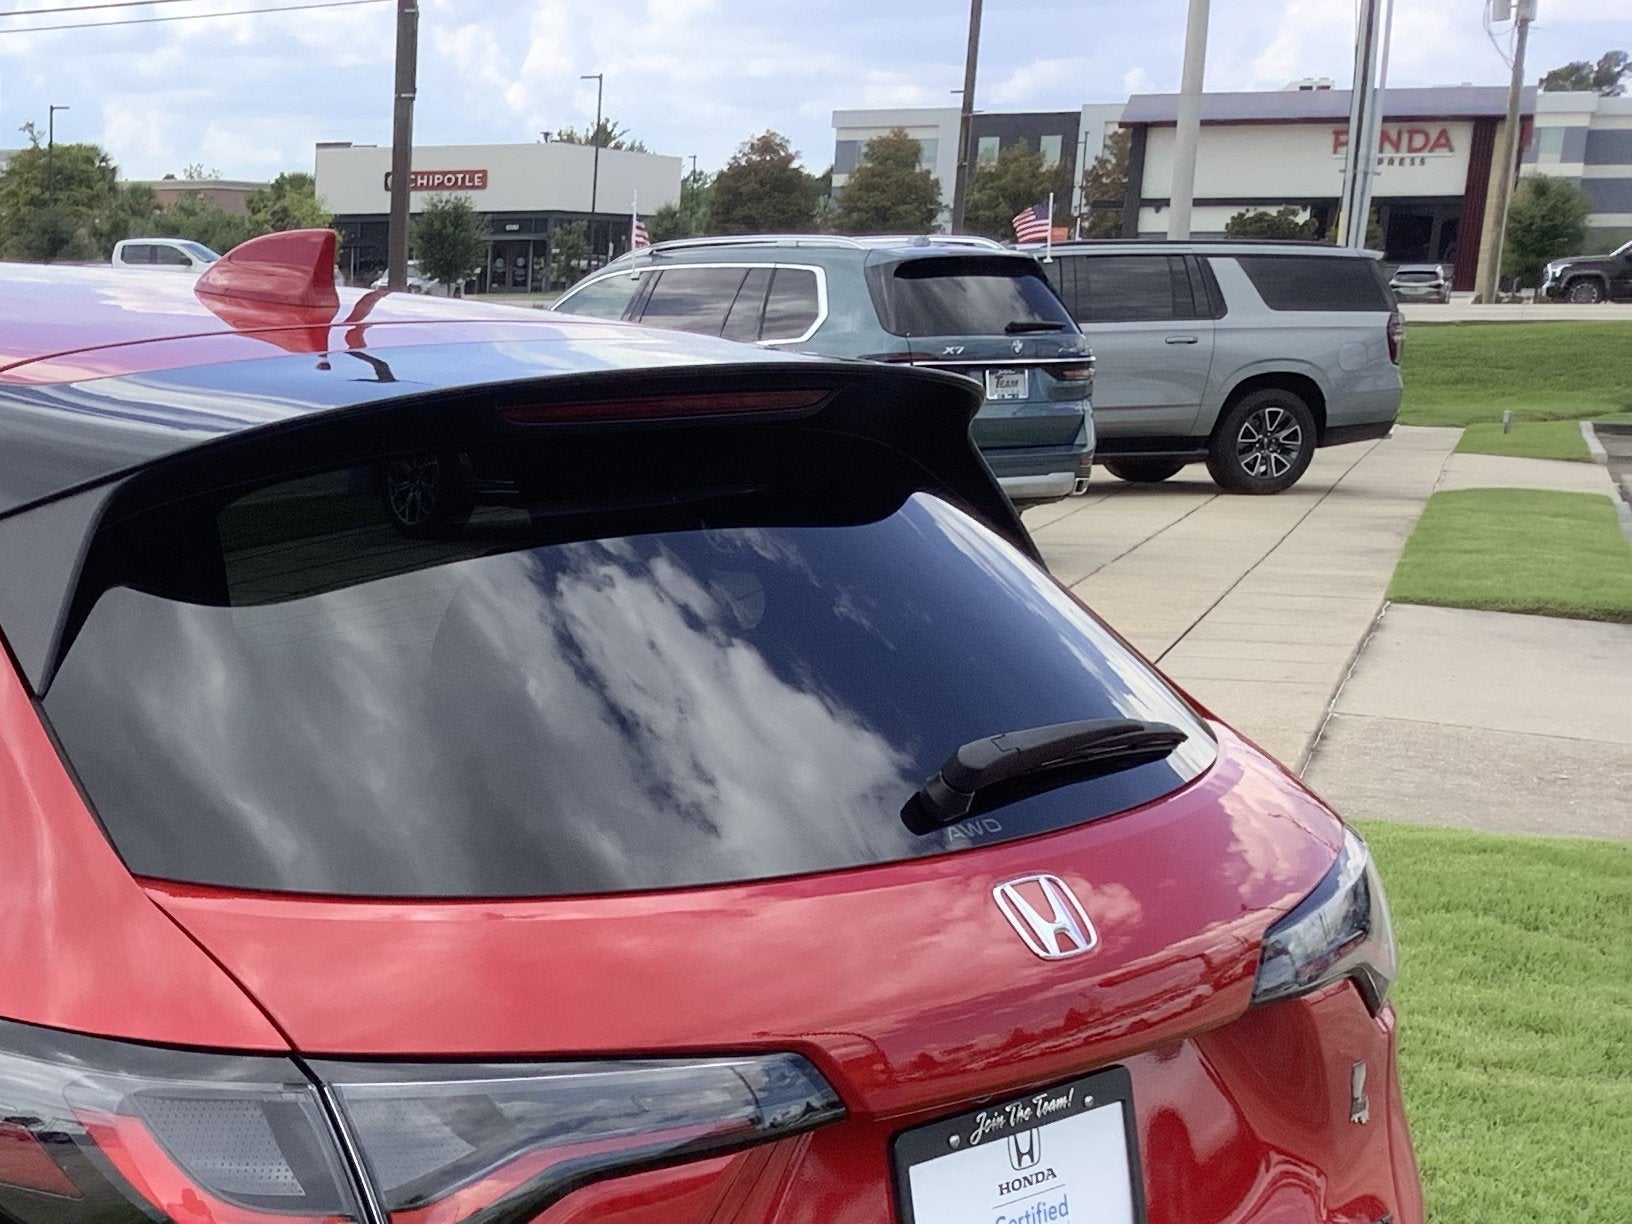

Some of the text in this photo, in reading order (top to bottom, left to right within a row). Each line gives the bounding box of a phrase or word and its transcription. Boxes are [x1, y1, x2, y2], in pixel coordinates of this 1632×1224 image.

[1332, 128, 1455, 155] PNDA
[1377, 156, 1426, 167] PRESS
[942, 346, 966, 355] X7
[947, 818, 1003, 842] AWD
[970, 1087, 1074, 1145] Join The Team!
[998, 1167, 1058, 1196] HONDA
